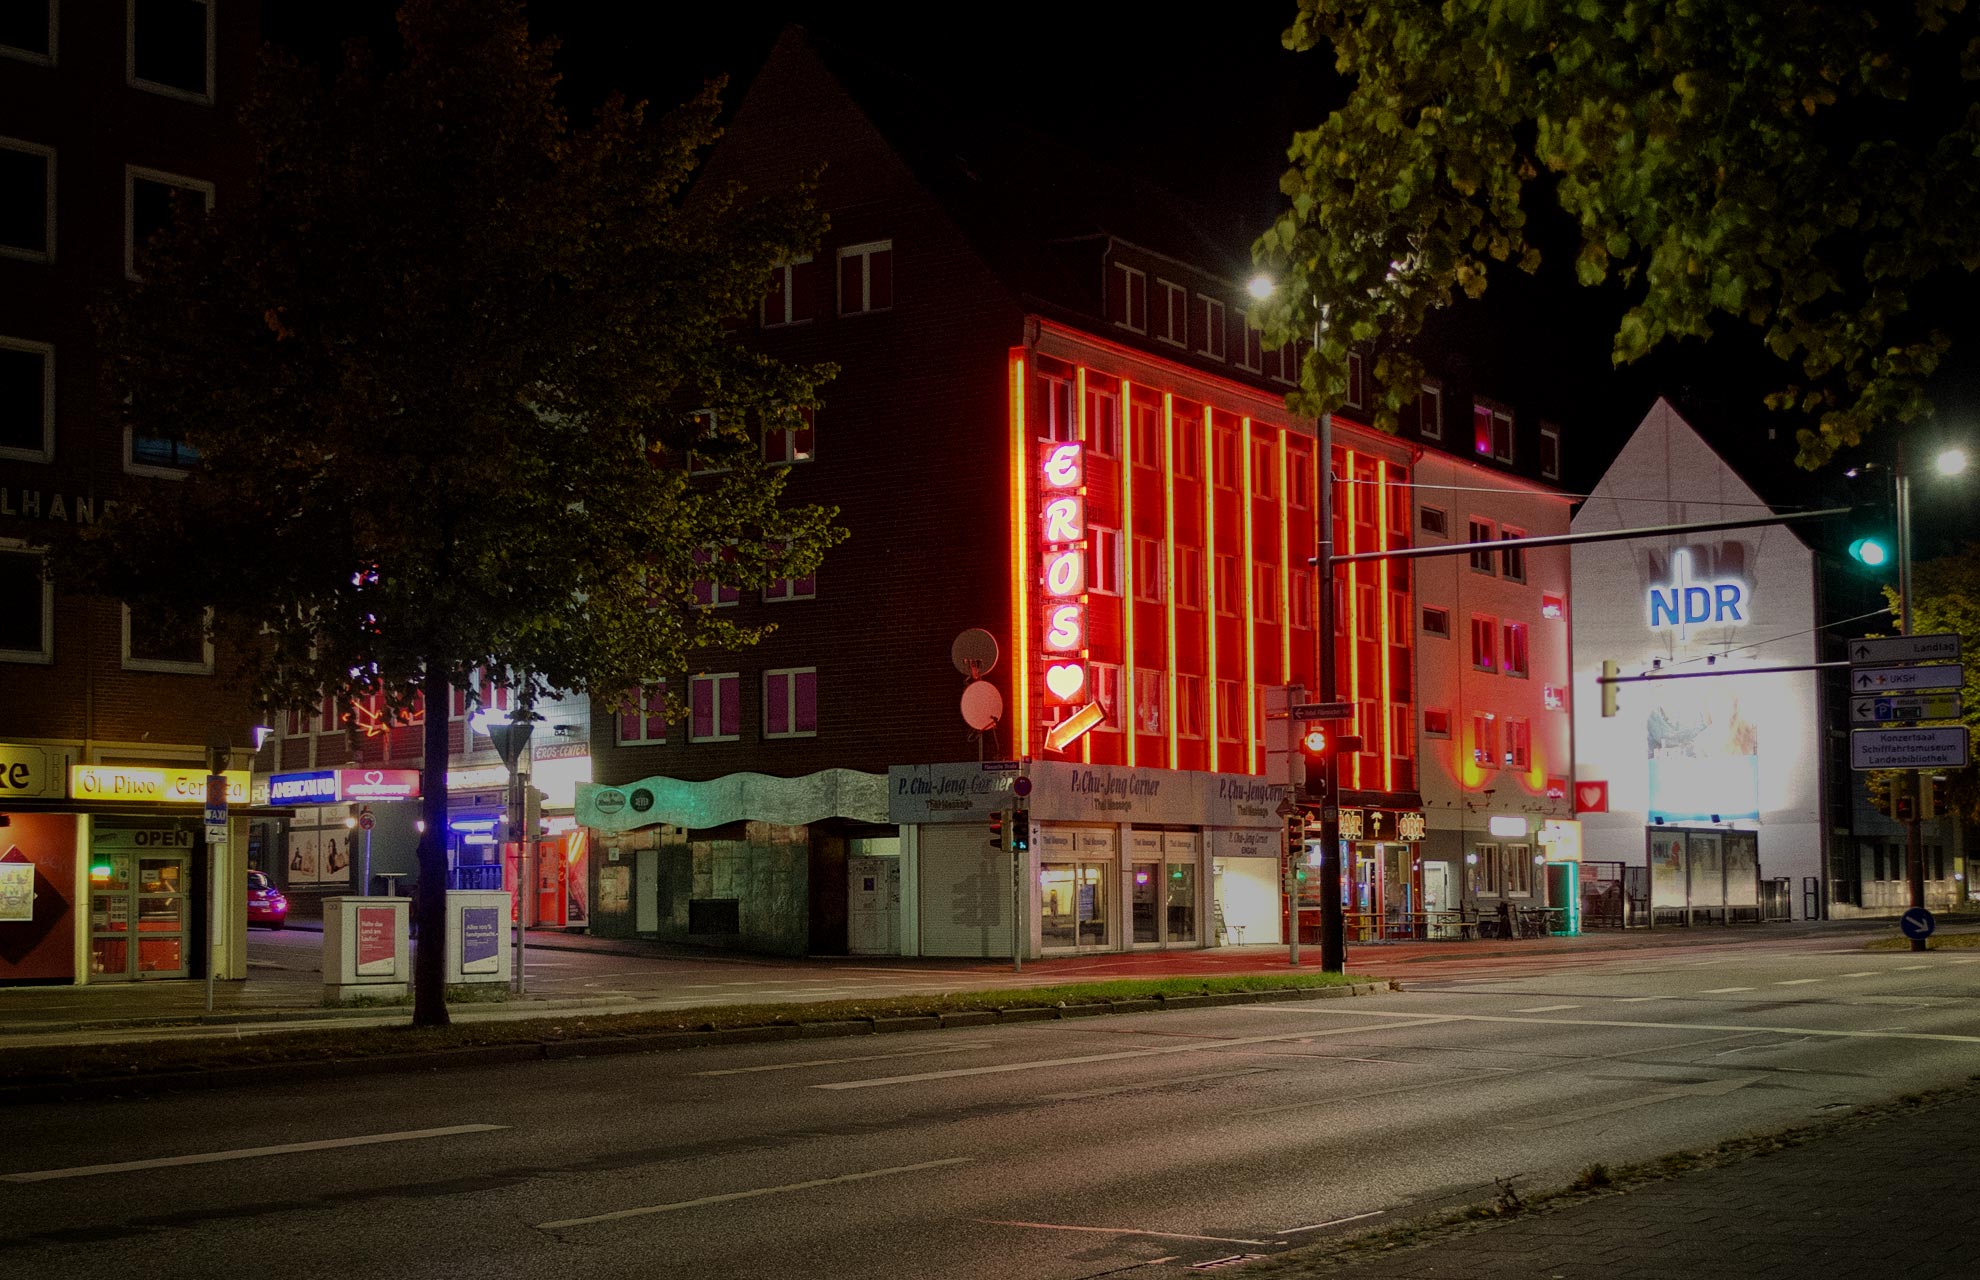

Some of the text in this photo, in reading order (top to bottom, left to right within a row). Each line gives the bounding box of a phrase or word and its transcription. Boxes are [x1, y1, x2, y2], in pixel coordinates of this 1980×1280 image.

[1043, 444, 1080, 647] EROS
[1650, 584, 1742, 626] NDR
[1913, 642, 1955, 653] Landtag
[1889, 675, 1916, 683] UKSH
[1880, 733, 1935, 742] Konzertsaal
[535, 743, 587, 760] EROS-CENTER
[1869, 754, 1948, 764] Landesbibliothek
[83, 770, 102, 793] Öl
[114, 774, 156, 794] Piwo
[1081, 770, 1128, 799] Chu-Jeng
[1129, 774, 1160, 796] Corner
[1228, 779, 1265, 805] Chu-Jeng
[1399, 817, 1425, 838] ORT
[134, 830, 188, 846] OPEN
